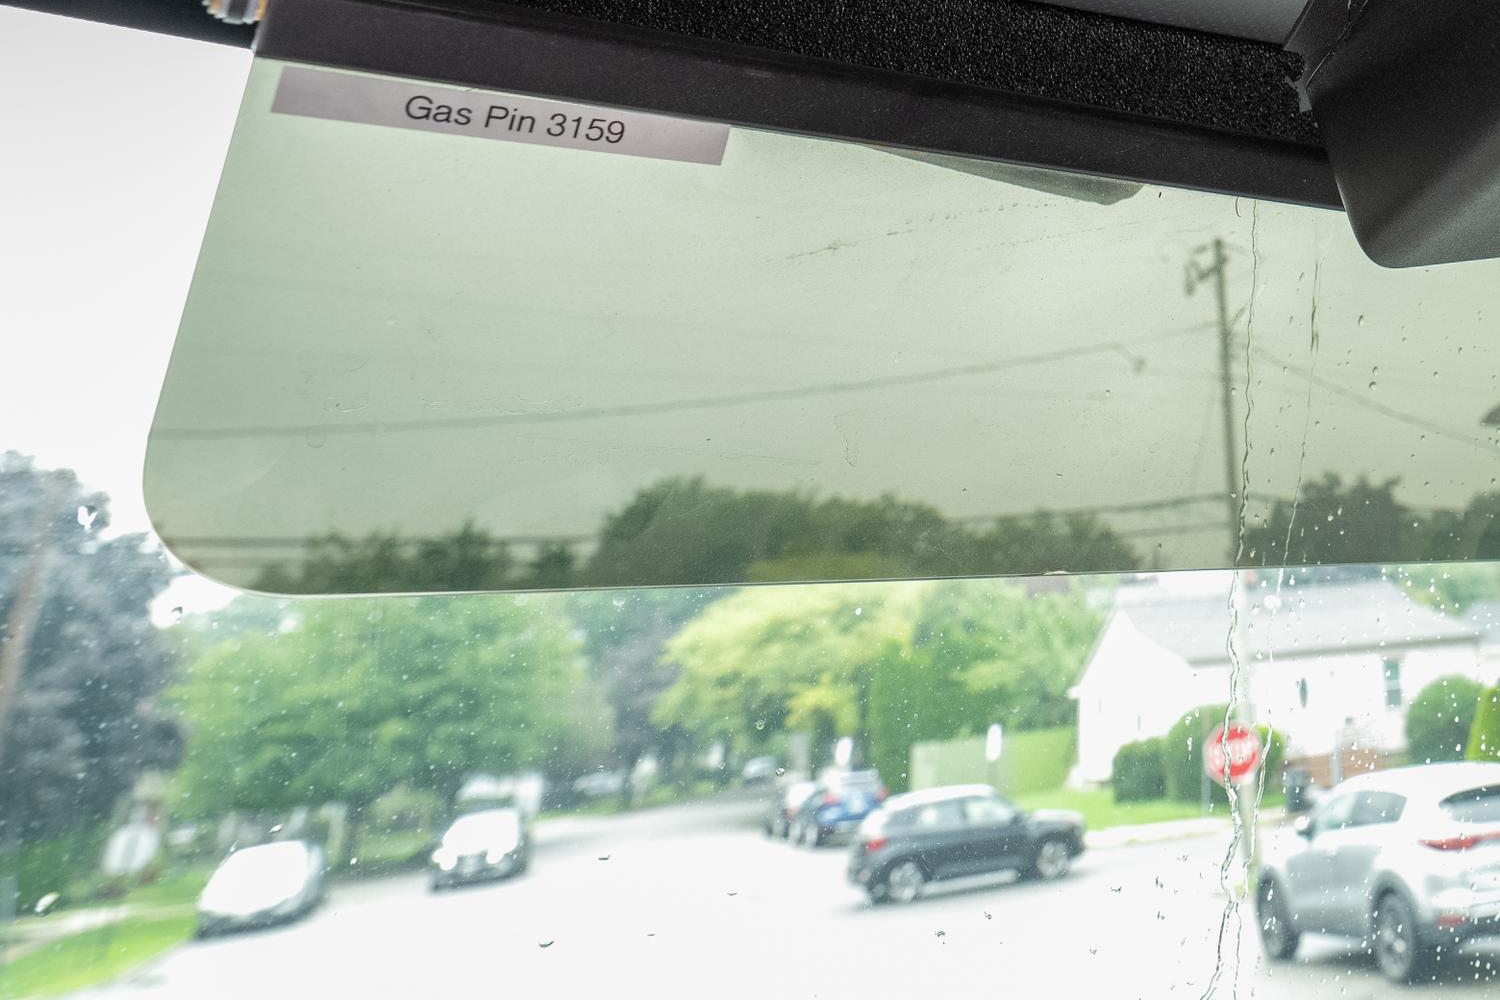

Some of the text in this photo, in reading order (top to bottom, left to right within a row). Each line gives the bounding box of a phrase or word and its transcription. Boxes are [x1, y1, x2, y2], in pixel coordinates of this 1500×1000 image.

[404, 95, 626, 145] Gas Pin 3159
